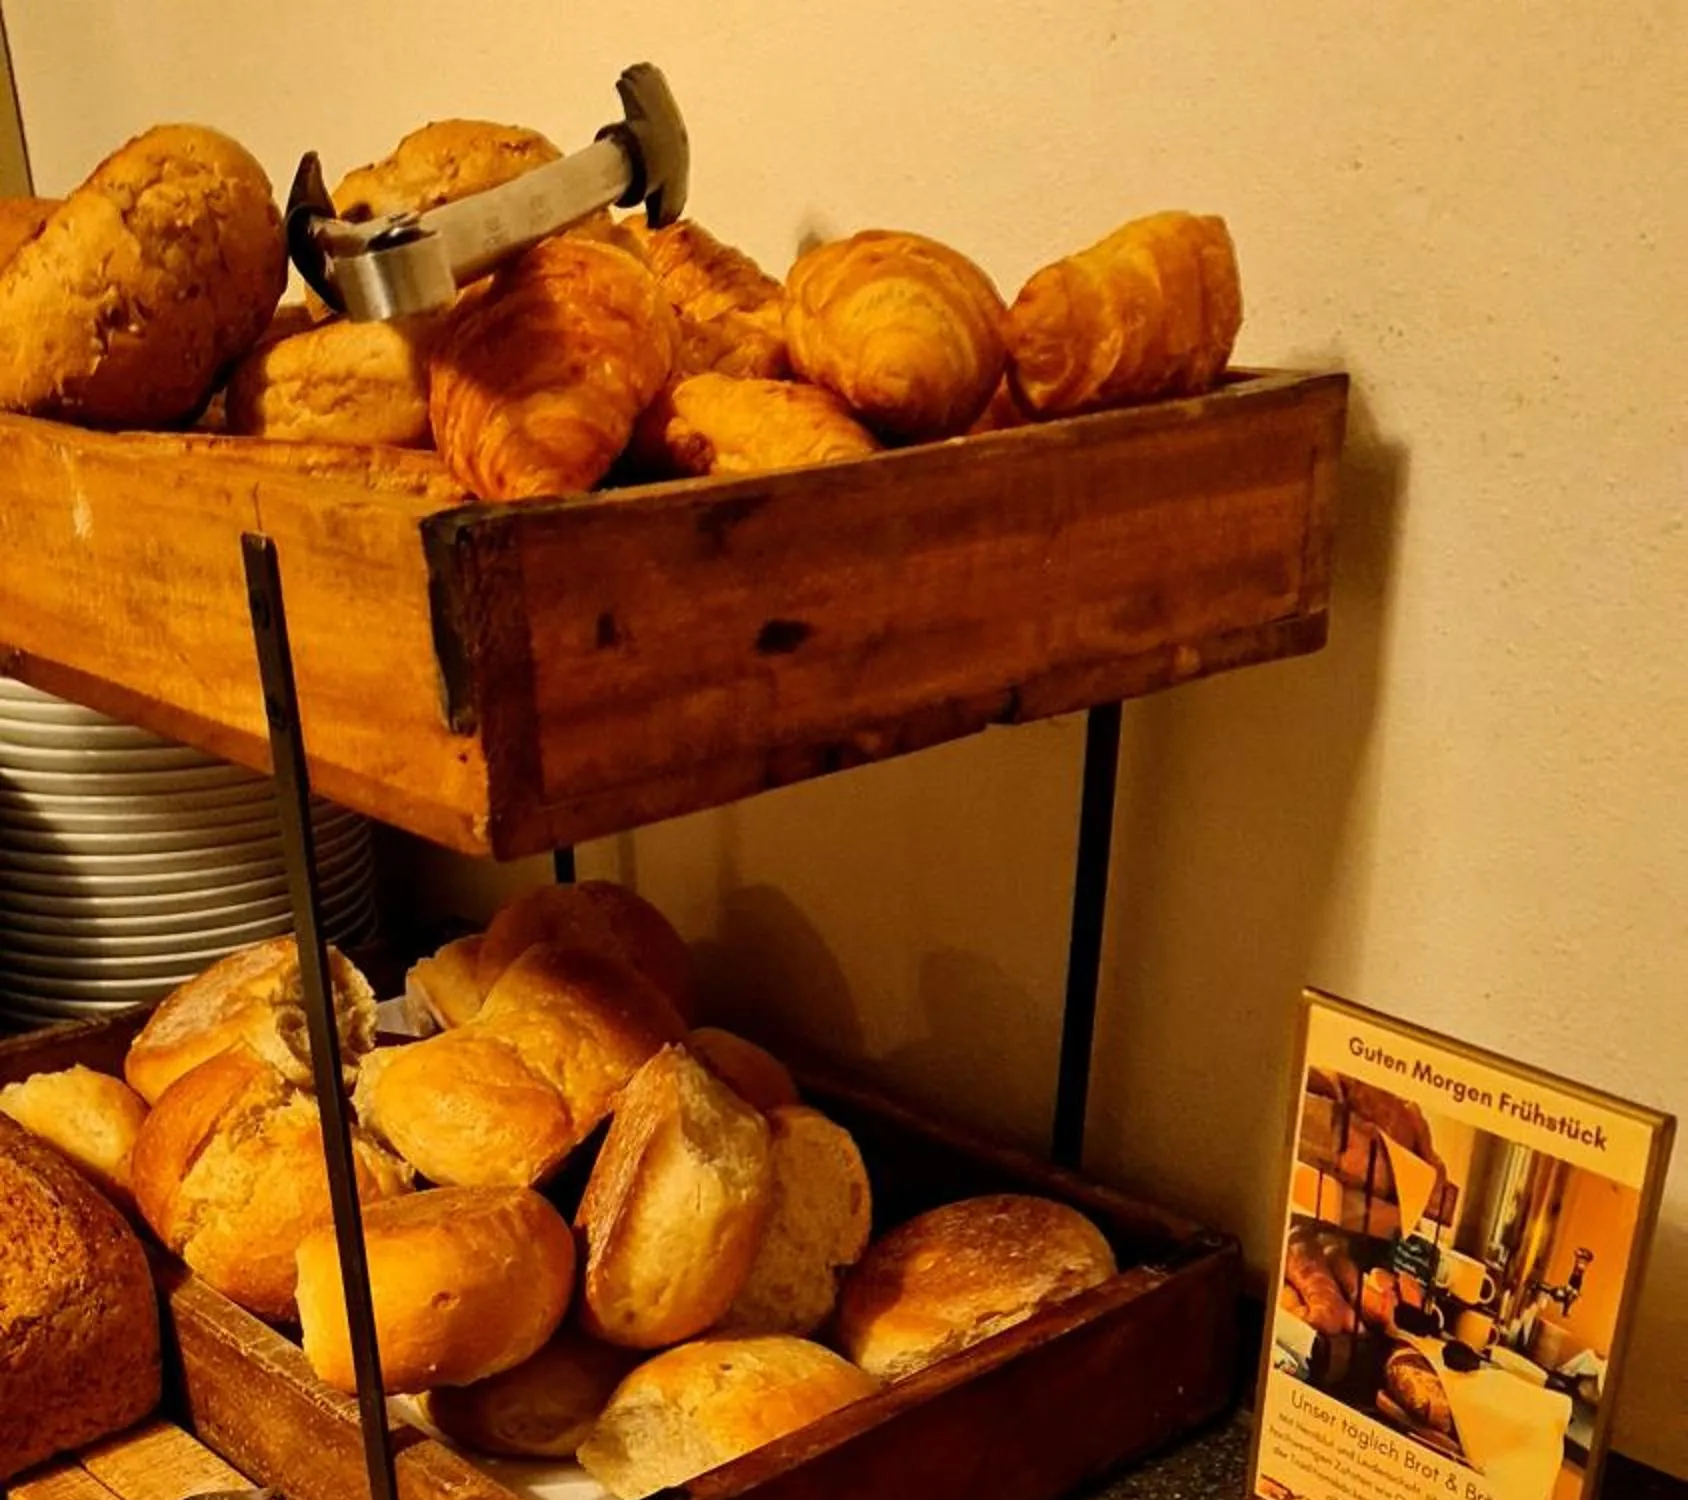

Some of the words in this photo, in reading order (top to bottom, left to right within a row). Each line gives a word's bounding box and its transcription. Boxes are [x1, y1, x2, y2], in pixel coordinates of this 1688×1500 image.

[1349, 1036, 1408, 1073] Guten
[1411, 1060, 1493, 1107] Morgen
[1498, 1091, 1609, 1151] Frühstück
[1290, 1389, 1337, 1426] Unser
[1404, 1451, 1440, 1482] Brot
[1444, 1472, 1458, 1495] &
